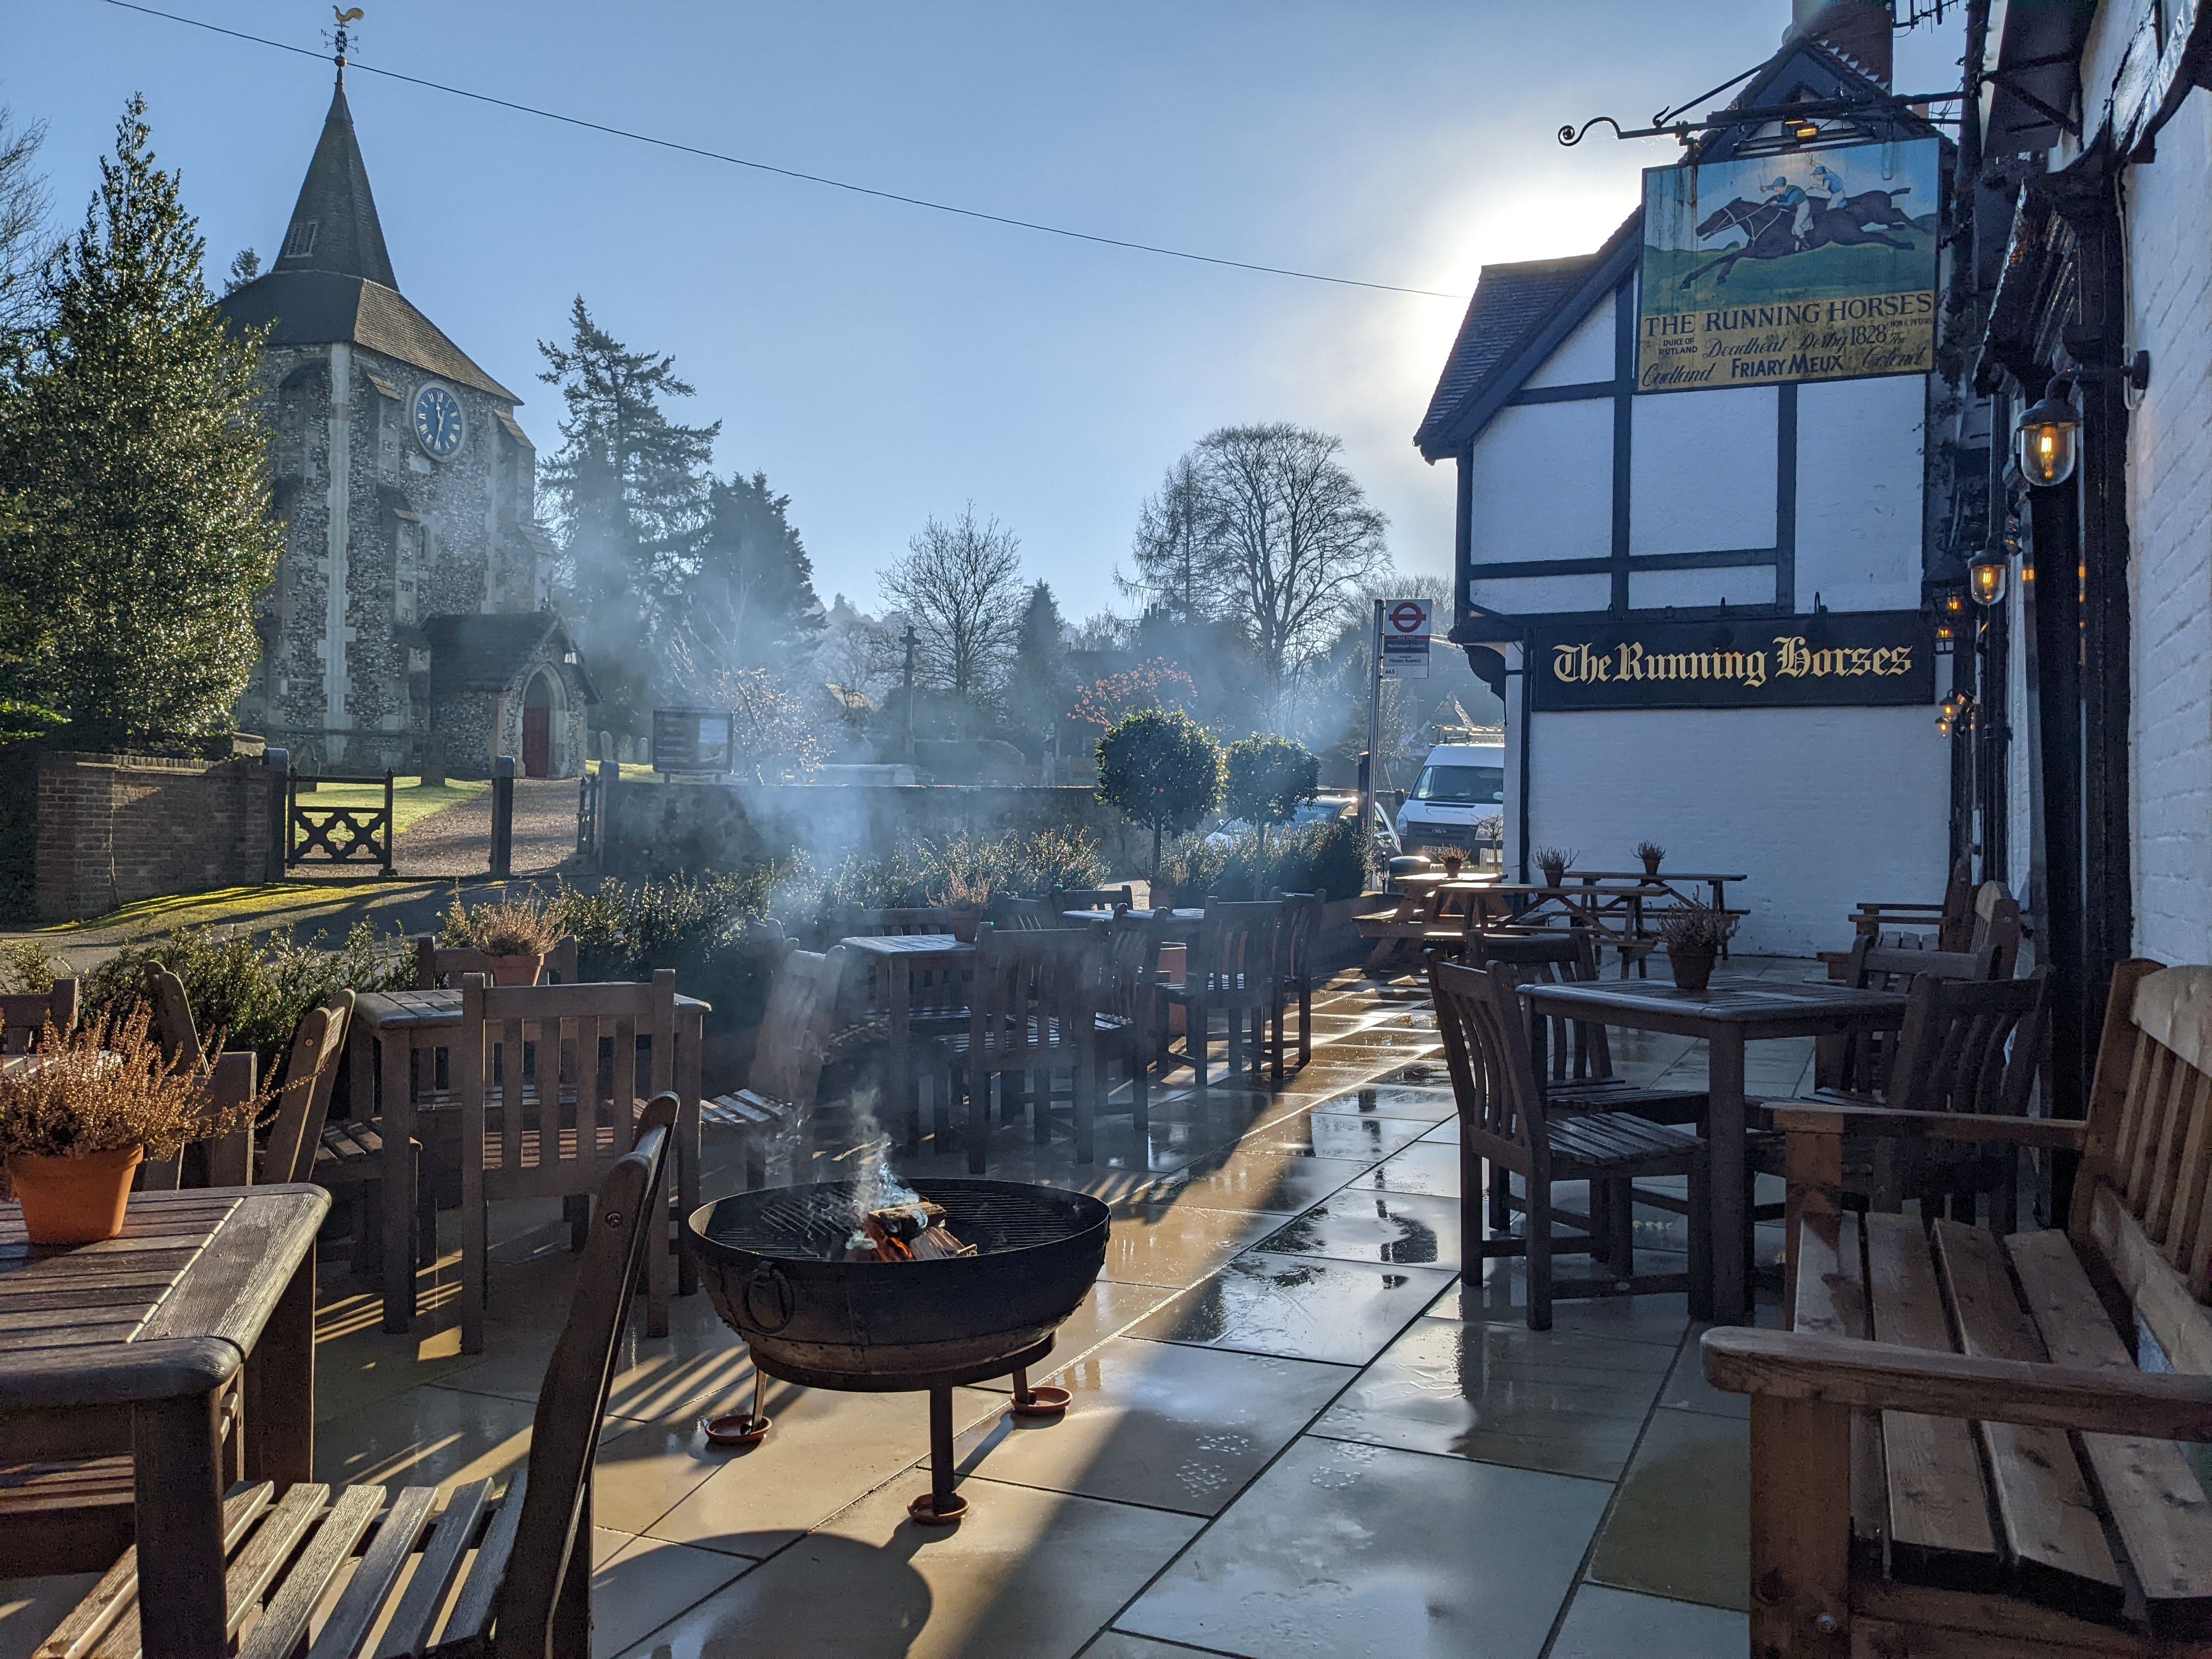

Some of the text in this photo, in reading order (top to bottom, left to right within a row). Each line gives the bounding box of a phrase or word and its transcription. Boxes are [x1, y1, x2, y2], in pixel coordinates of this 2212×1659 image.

[1645, 294, 1932, 337] THE RUNNING HORSES
[1663, 337, 1695, 347] DUKE OF
[1849, 323, 1887, 346] 1828
[1659, 346, 1698, 356] RUTLAND
[1730, 358, 1787, 378] FRIARY
[1787, 353, 1844, 375] MEUX
[1551, 635, 1914, 687] The Running Horses
